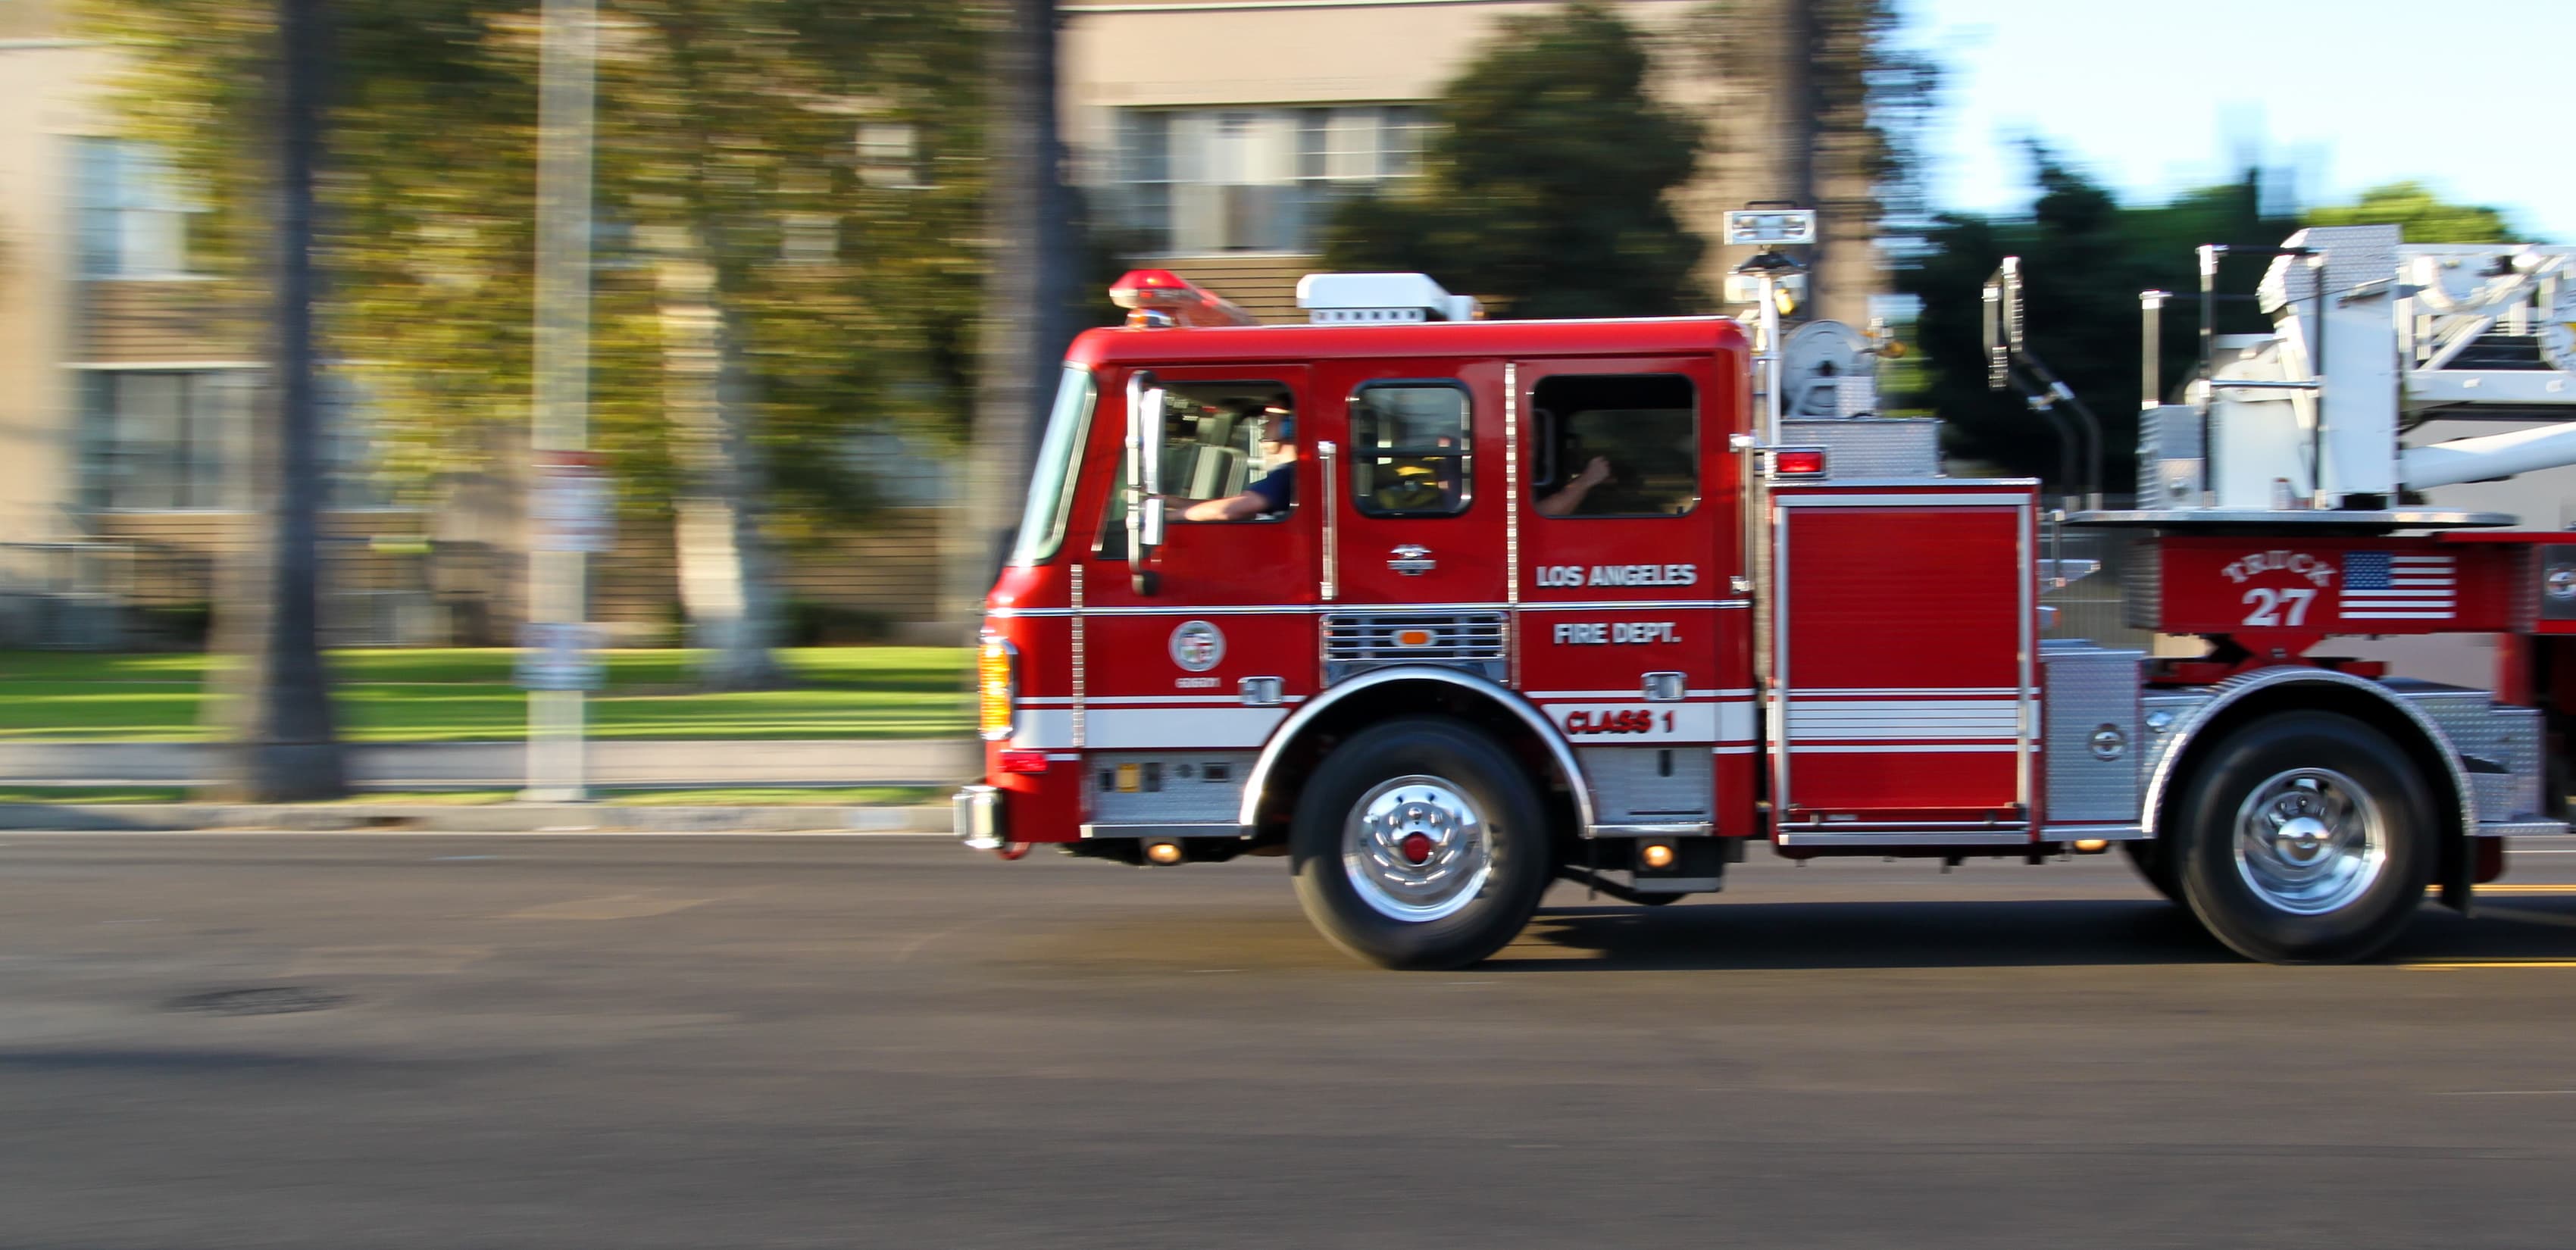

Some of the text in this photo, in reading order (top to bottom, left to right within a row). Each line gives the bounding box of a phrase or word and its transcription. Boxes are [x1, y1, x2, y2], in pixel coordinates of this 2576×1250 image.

[1537, 564, 1697, 586] LOS ANGELES
[2221, 550, 2337, 587] TRUCK
[2241, 588, 2318, 627] 27
[1553, 622, 1682, 644] FIRE DEPT.
[1566, 709, 1674, 734] CLASS 1
